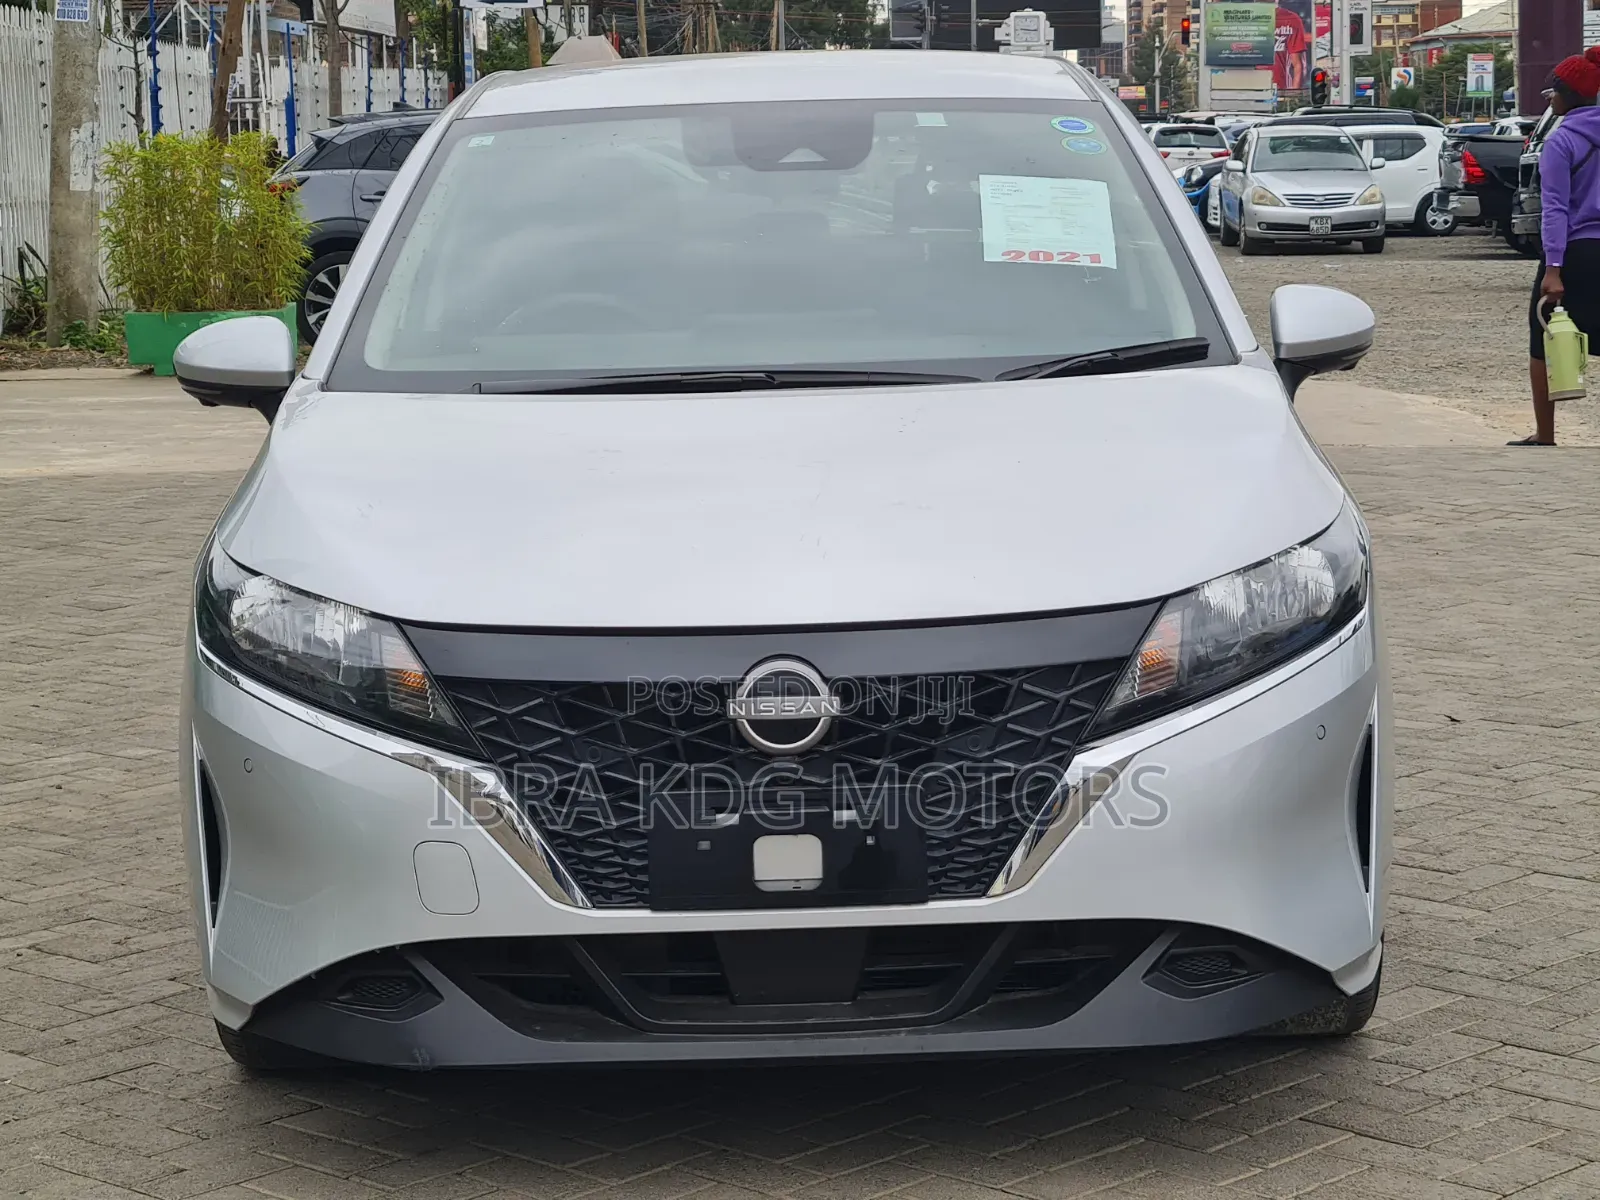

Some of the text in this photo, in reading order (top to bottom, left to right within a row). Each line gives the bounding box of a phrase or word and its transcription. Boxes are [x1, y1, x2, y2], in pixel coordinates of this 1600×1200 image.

[1315, 217, 1330, 225] KBX
[1001, 250, 1102, 264] 2021
[729, 699, 838, 717] NISSAN
